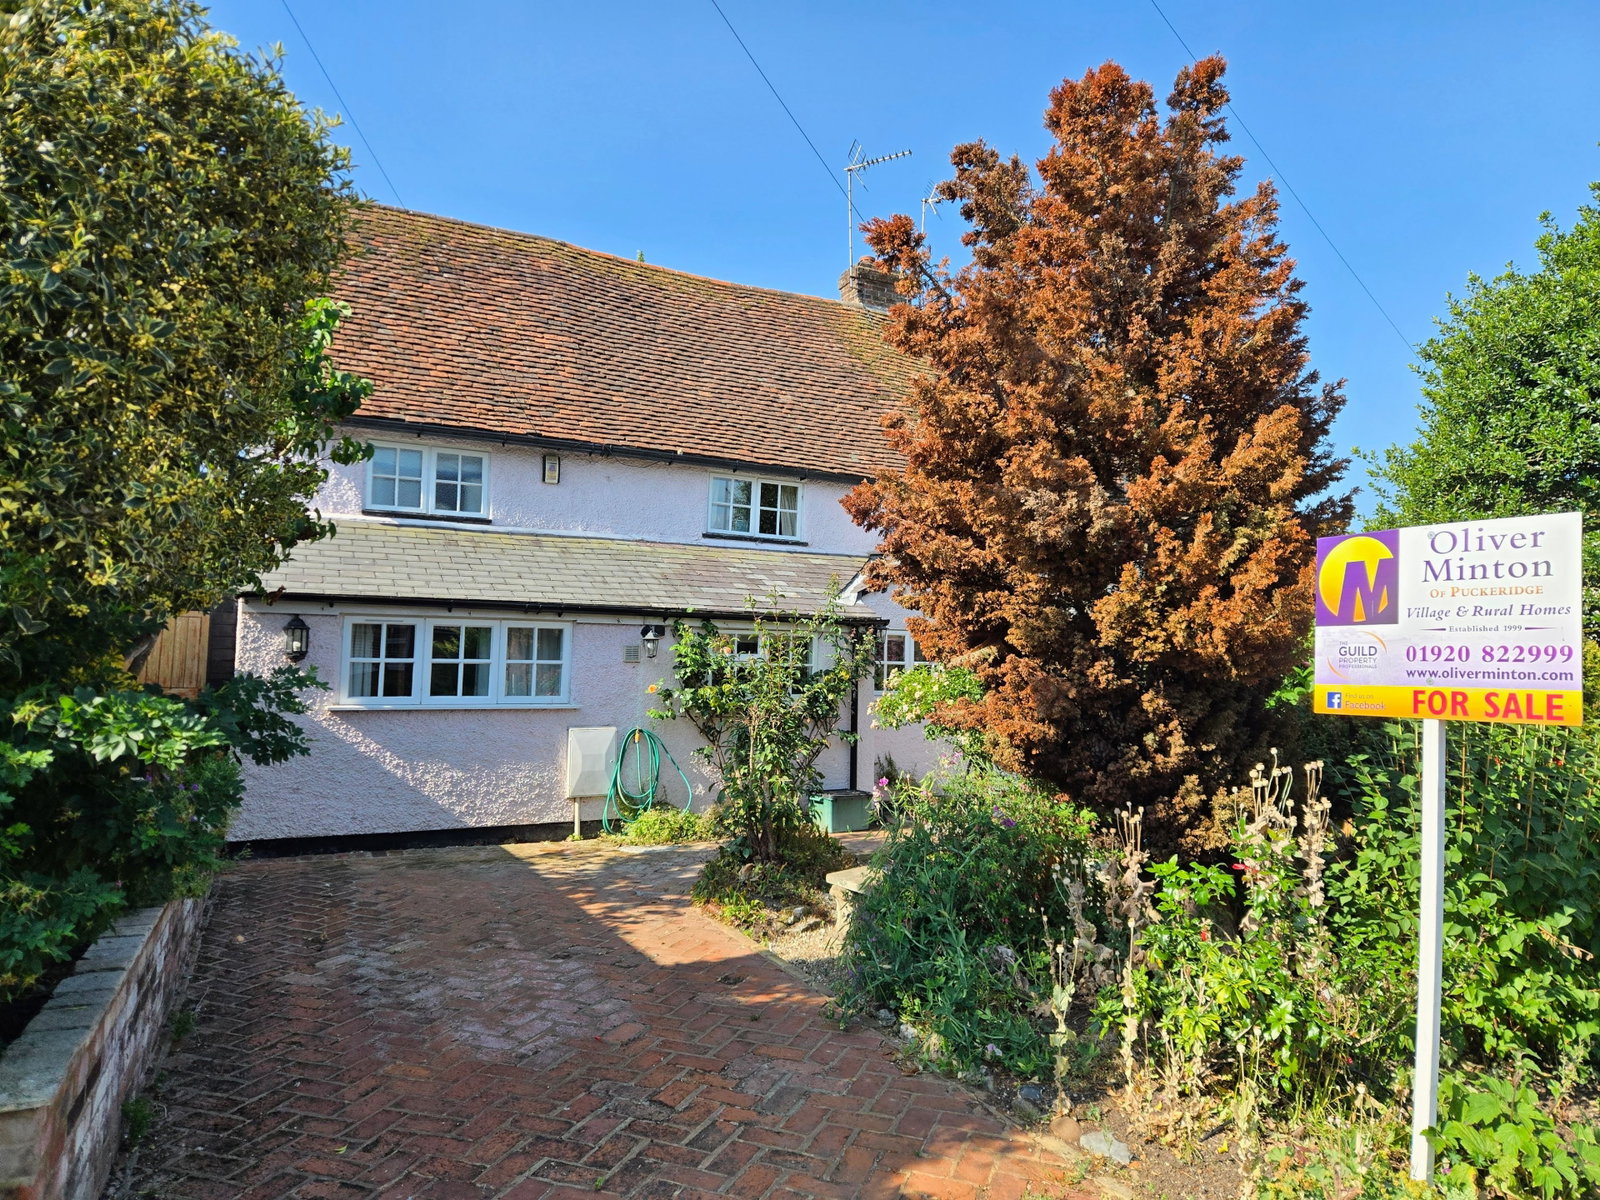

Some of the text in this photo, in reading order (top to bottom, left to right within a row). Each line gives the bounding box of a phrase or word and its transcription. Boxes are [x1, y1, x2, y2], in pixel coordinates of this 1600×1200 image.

[1430, 527, 1545, 555] Oliver
[1422, 557, 1554, 583] Minton
[1451, 585, 1544, 598] PUCKERIDGE
[1407, 603, 1572, 621] Village & Rural Homes
[1449, 625, 1499, 633] Established
[1338, 646, 1378, 657] GUILD
[1405, 645, 1574, 664] 01920 822999
[1405, 667, 1574, 681] www.oliverminton.com
[1345, 701, 1385, 709] Facebook
[1412, 690, 1565, 721] FOR SALE
